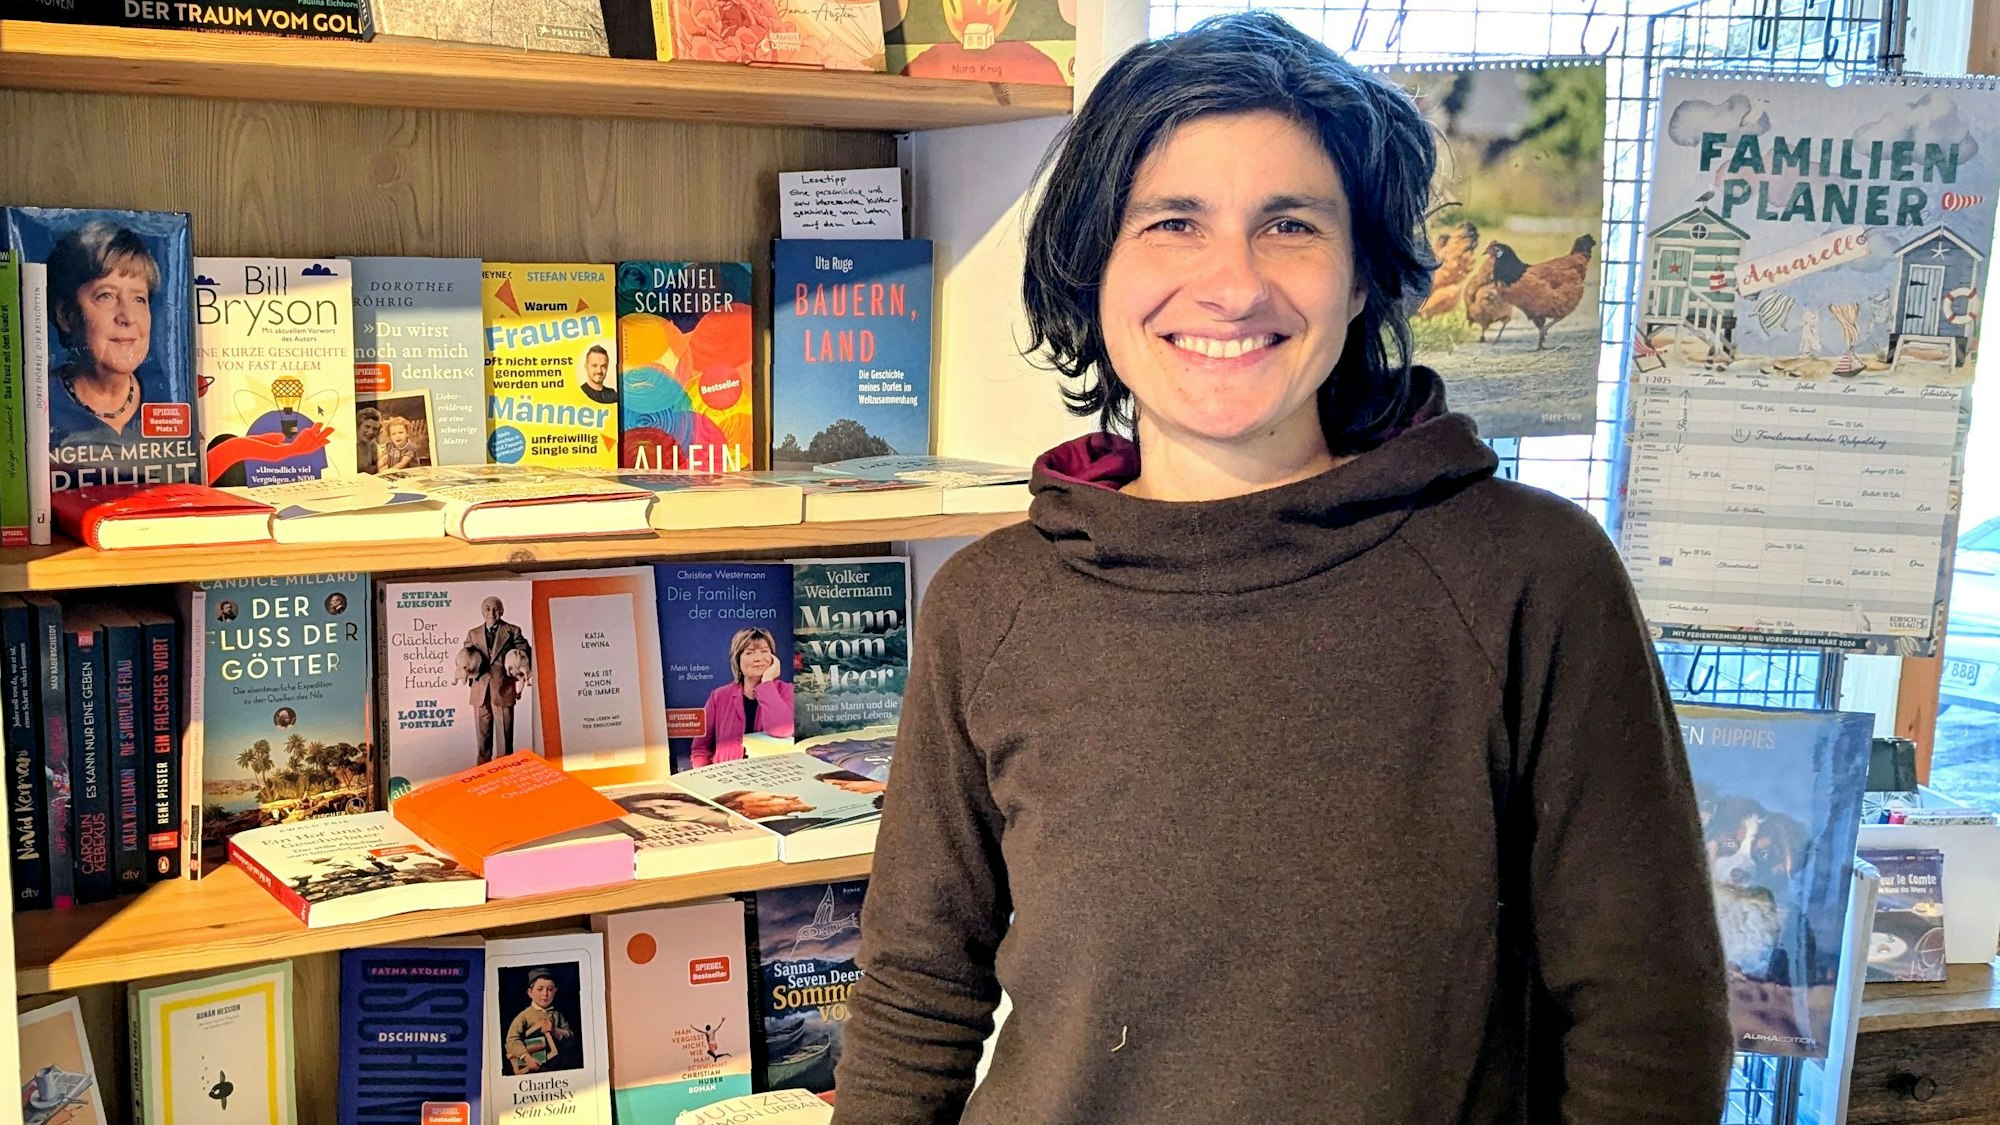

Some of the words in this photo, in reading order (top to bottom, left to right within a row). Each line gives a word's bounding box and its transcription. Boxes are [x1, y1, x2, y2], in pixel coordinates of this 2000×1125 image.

[124, 1, 170, 21] DER
[174, 3, 253, 27] TRAUM
[256, 8, 308, 31] VOM
[777, 0, 809, 18] Jane
[812, 3, 858, 23] Austen
[952, 64, 976, 74] Nora
[980, 64, 1002, 77] Krug
[1699, 132, 1960, 184] FAMILIEN
[801, 175, 847, 186] Lesetipp
[789, 188, 810, 197] Eine
[868, 185, 883, 194] und
[1721, 179, 1929, 226] PLANER
[851, 218, 876, 226] Land
[815, 255, 830, 270] Uta
[832, 256, 854, 273] Ruge
[245, 265, 287, 296] Bill
[527, 271, 567, 282] STEFAN
[570, 272, 606, 282] VERRA
[653, 267, 716, 289] DANIEL
[370, 281, 454, 292] DOROTHEE
[524, 302, 568, 311] Warum
[634, 291, 734, 313] SCHREIBER
[196, 287, 338, 337] Bryson
[406, 322, 449, 338] wirst
[484, 314, 602, 352] Frauen
[222, 347, 265, 358] KURZE
[268, 347, 348, 358] GESCHICHTE
[355, 343, 397, 359] noch
[402, 348, 422, 359] an
[427, 343, 468, 359] mich
[804, 329, 875, 363] LAND
[217, 361, 244, 371] VON
[248, 361, 278, 371] FAST
[280, 361, 322, 371] ALLEM
[484, 357, 503, 366] oft
[505, 357, 538, 366] nicht
[540, 357, 573, 366] ernst
[495, 369, 562, 379] genommen
[858, 369, 870, 379] Die
[871, 369, 904, 379] Geschichte
[493, 380, 538, 389] werden
[541, 379, 564, 389] und
[858, 382, 880, 392] meines
[882, 382, 902, 392] Dorfes
[487, 394, 610, 429] Männer
[531, 434, 599, 445] unfreiwillig
[120, 440, 197, 461] MERKEL
[531, 445, 569, 456] Single
[572, 444, 598, 455] sind
[298, 465, 311, 473] viel
[200, 575, 279, 590] CANDICE
[285, 571, 359, 586] MILLARD
[677, 570, 712, 579] Christine
[714, 570, 766, 580] Westermann
[826, 569, 871, 584] Volker
[401, 591, 448, 600] STEFAN
[667, 586, 692, 601] Die
[697, 584, 757, 601] Familien
[804, 585, 893, 599] Weidermann
[251, 595, 310, 619] DER
[396, 600, 453, 609] LUKSCHY
[688, 603, 713, 619] der
[717, 603, 777, 619] anderen
[413, 618, 438, 632] Der
[799, 605, 898, 634] Mann
[391, 632, 460, 647] Glückliche
[584, 631, 605, 640] KATJA
[1672, 630, 1686, 638] MIT
[1686, 631, 1748, 641] FERIENTERMINEN
[1748, 634, 1765, 642] UND
[1765, 635, 1804, 645] VORSCHAU
[1804, 637, 1817, 645] BIS
[1817, 637, 1838, 646] MÄRZ
[1838, 639, 1857, 647] 2026
[581, 640, 610, 649] LEWINA
[809, 637, 886, 660] vom
[403, 647, 449, 664] schlägt
[221, 652, 342, 682] GÖTTER
[409, 661, 444, 675] keine
[583, 670, 600, 678] WAS
[602, 669, 613, 677] IST
[1951, 662, 1976, 680] 888
[82, 661, 94, 699] GEBEN
[404, 676, 449, 689] Hunde
[584, 679, 612, 688] SCHON
[247, 683, 297, 694] abenteuerliche
[578, 688, 593, 697] FÜR
[594, 687, 621, 696] IMMER
[415, 700, 438, 708] EIN
[805, 702, 839, 712] Thomas
[840, 702, 865, 710] Mann
[866, 700, 883, 709] und
[884, 699, 898, 708] die
[397, 708, 456, 720] LORIOT
[811, 711, 834, 722] Liebe
[835, 711, 861, 721] seines
[863, 709, 893, 720] Lebens
[400, 719, 455, 730] PORTRÄT
[120, 741, 136, 756] DIE
[156, 762, 169, 799] PFISTER
[86, 785, 97, 798] ES
[323, 819, 350, 829] FRIE
[280, 831, 381, 850] Geschwister
[294, 831, 327, 842] Hof
[122, 871, 140, 880] dtv
[1896, 873, 1906, 885] le
[1908, 873, 1937, 885] Comte
[21, 887, 39, 898] dtv
[370, 967, 407, 976] FATMA
[410, 967, 461, 976] AYDEMIR
[695, 961, 724, 971] SPIEGEL
[773, 962, 816, 978] Sanna
[692, 971, 728, 981] Bestseller
[788, 973, 828, 989] Seven
[378, 1032, 447, 1043] DSCHINNS
[671, 1034, 704, 1045] VERGISST
[1742, 1032, 1817, 1045] ALPHAEDITION
[687, 1061, 728, 1072] SCHWIMMT
[681, 1069, 721, 1080] CHRISTIAN
[698, 1076, 724, 1085] HUBER
[518, 1077, 569, 1092] Charles
[688, 1084, 717, 1094] ROMAN
